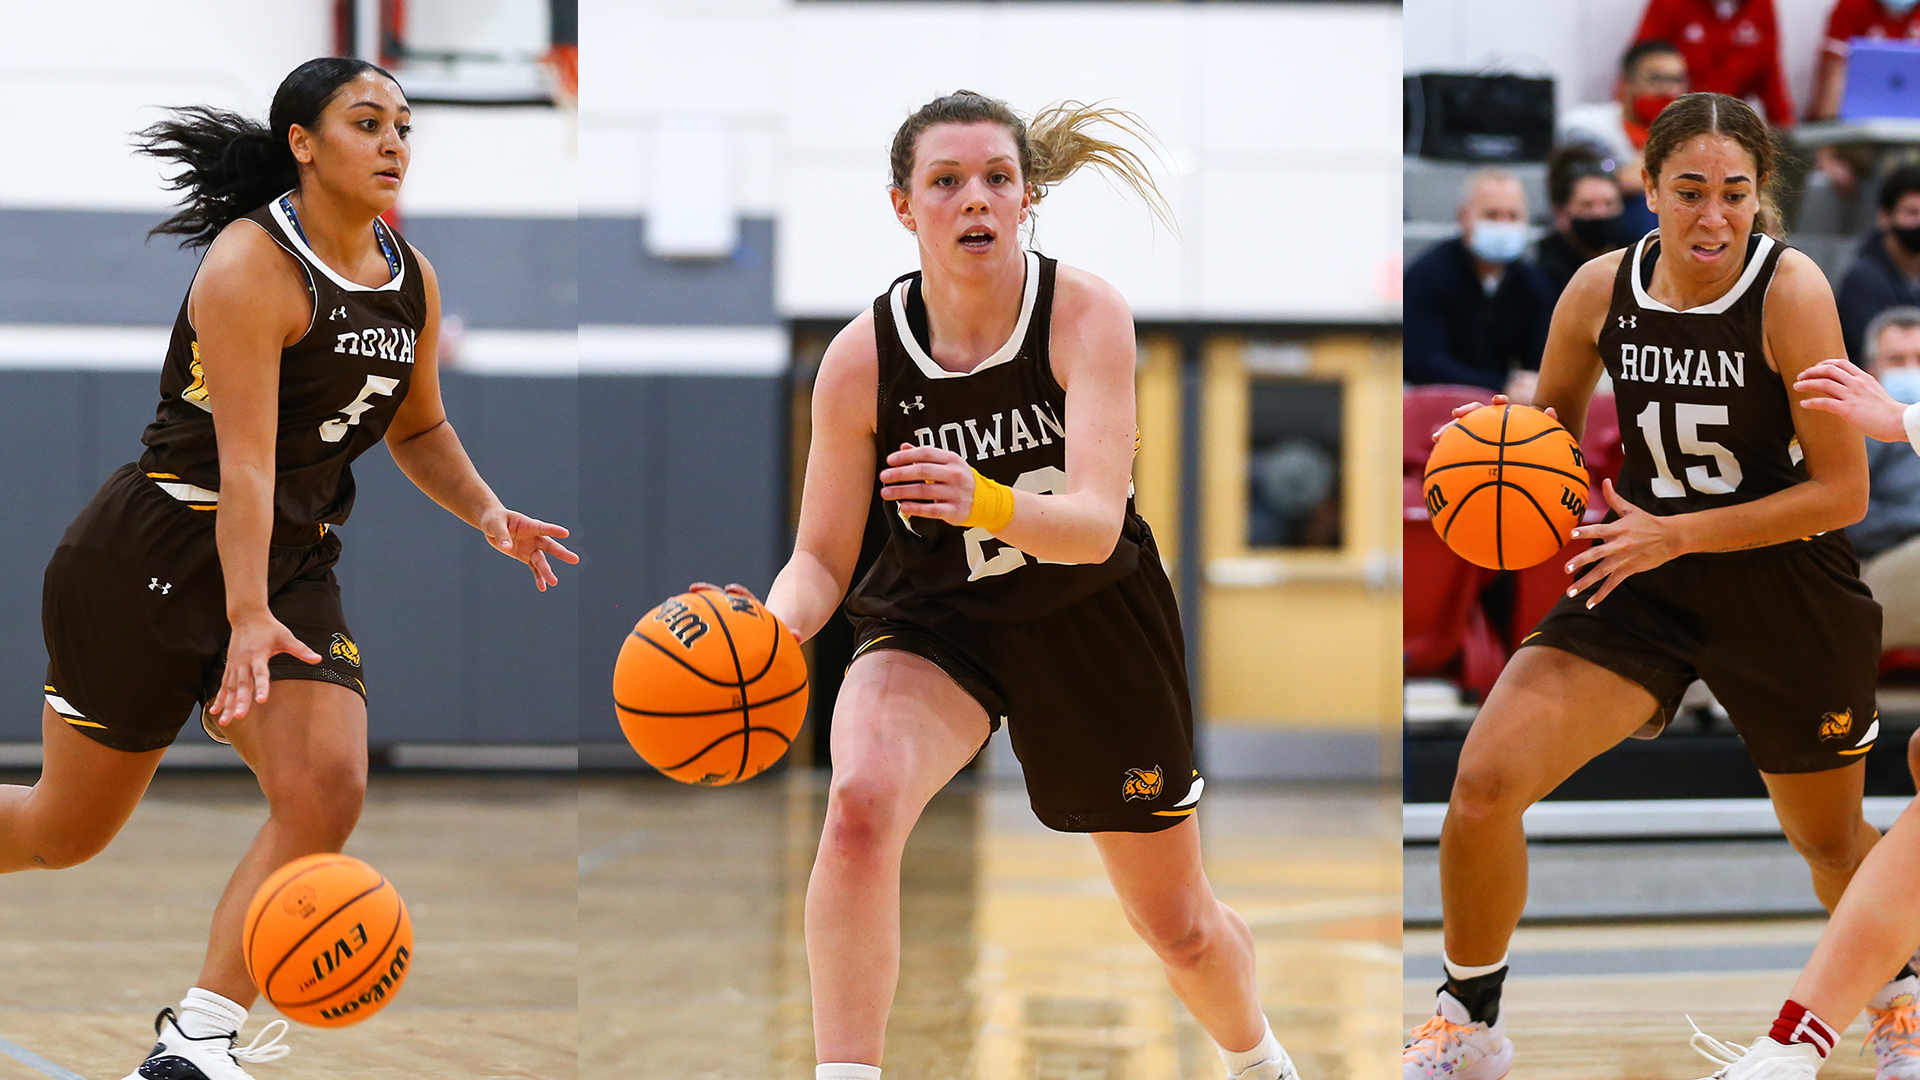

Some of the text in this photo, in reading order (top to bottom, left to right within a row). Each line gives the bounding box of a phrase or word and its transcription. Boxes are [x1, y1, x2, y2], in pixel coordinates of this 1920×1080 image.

[334, 327, 418, 364] ROWA
[1621, 343, 1745, 387] ROWAN
[319, 374, 400, 442] 5
[1636, 401, 1743, 498] 15
[313, 922, 368, 980] EVO
[320, 945, 409, 1020] Wilson
